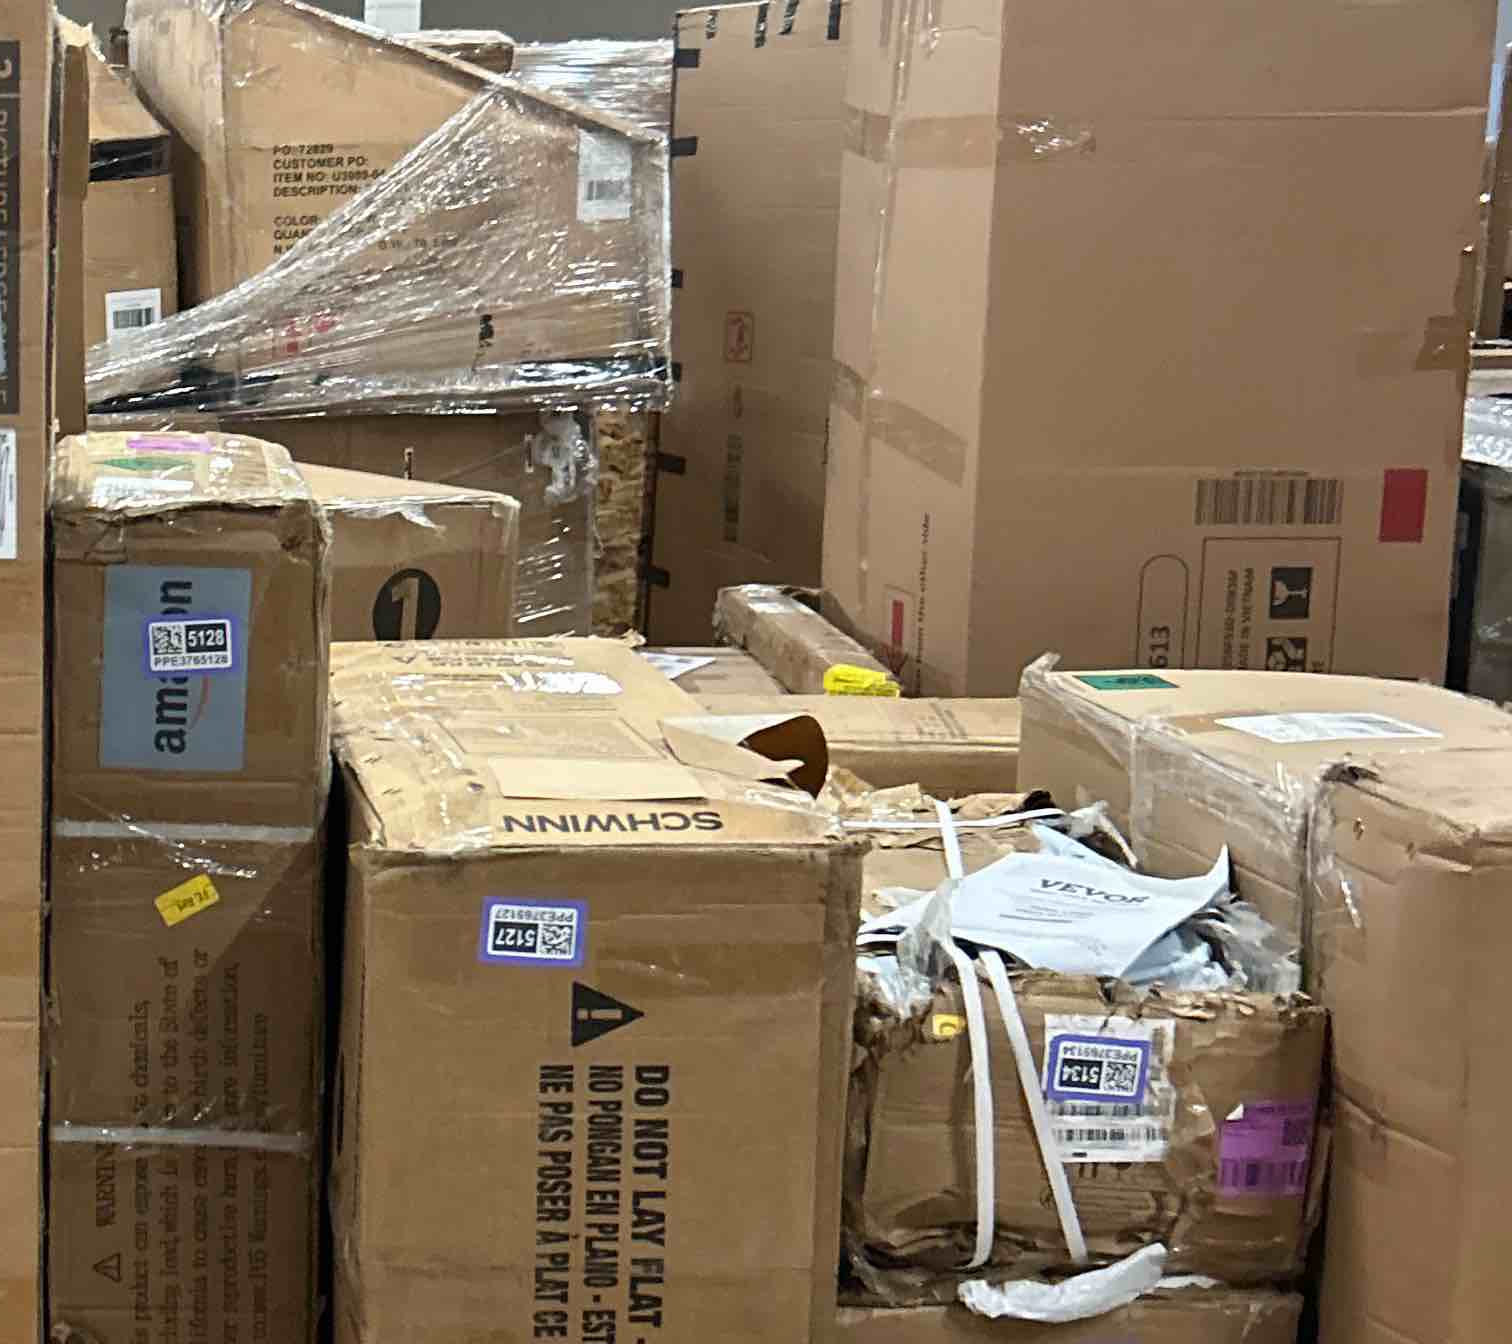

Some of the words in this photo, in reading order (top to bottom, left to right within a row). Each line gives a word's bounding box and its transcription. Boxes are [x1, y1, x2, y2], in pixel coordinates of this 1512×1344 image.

[273, 157, 344, 170] CUSTOMER
[273, 171, 302, 183] ITEM
[391, 576, 421, 641] 1
[187, 628, 225, 647] 5128
[504, 811, 724, 833] SCHWINN
[494, 927, 536, 947] 5127
[539, 1064, 574, 1094] NE
[588, 1065, 624, 1093] NO
[635, 1064, 670, 1107] DO
[1061, 1064, 1100, 1084] 5134
[537, 1101, 573, 1143] PAS
[587, 1100, 623, 1183] PONGAN
[633, 1119, 669, 1180] NOT
[536, 1150, 572, 1223] POSER
[585, 1189, 621, 1216] EN
[631, 1190, 667, 1248] LAY
[583, 1222, 620, 1289] PLANO
[534, 1252, 570, 1304] PLAT
[629, 1258, 665, 1328] FLAT
[532, 1310, 568, 1338] CE
